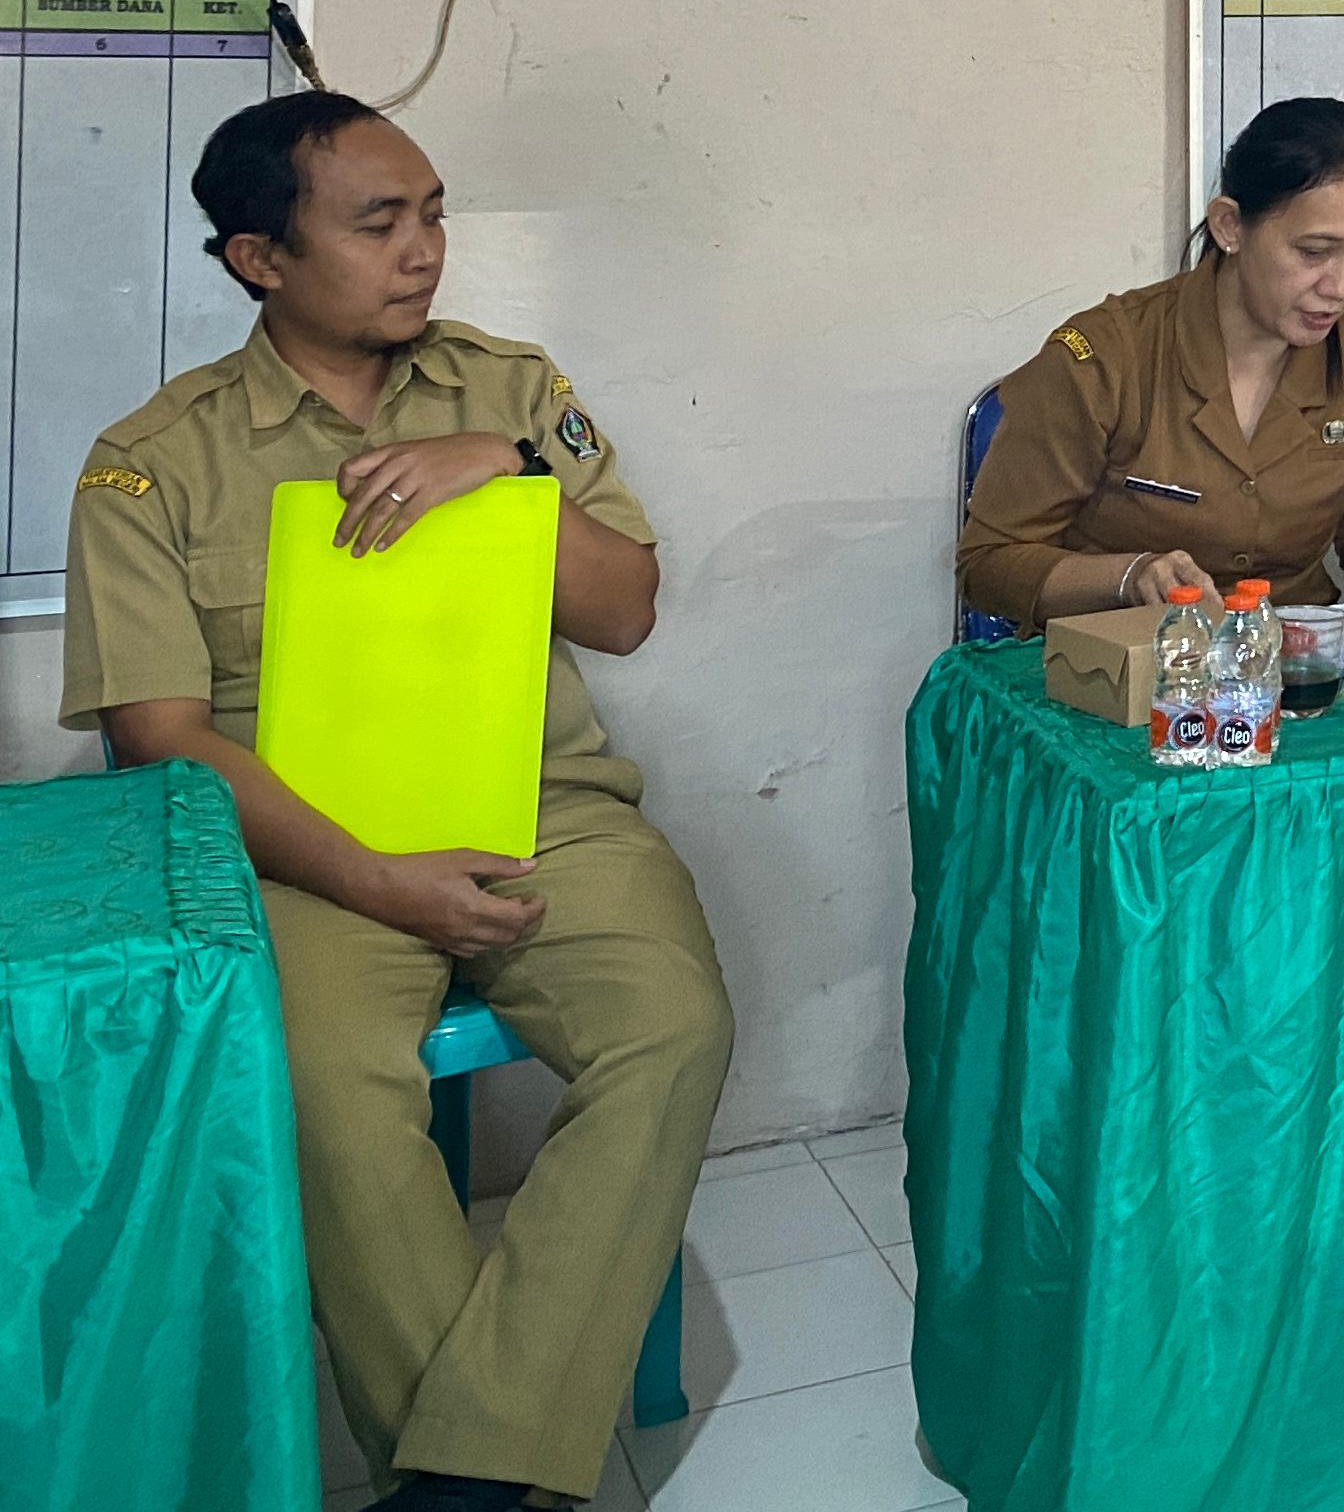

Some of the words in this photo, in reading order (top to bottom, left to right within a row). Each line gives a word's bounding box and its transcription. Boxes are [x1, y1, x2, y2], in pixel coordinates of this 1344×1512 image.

[116, 0, 164, 14] DANA
[203, 1, 243, 14] KET.
[95, 38, 106, 51] 6
[217, 40, 228, 52] 7
[1180, 722, 1205, 737] Cleo
[1223, 729, 1250, 745] Cleo
